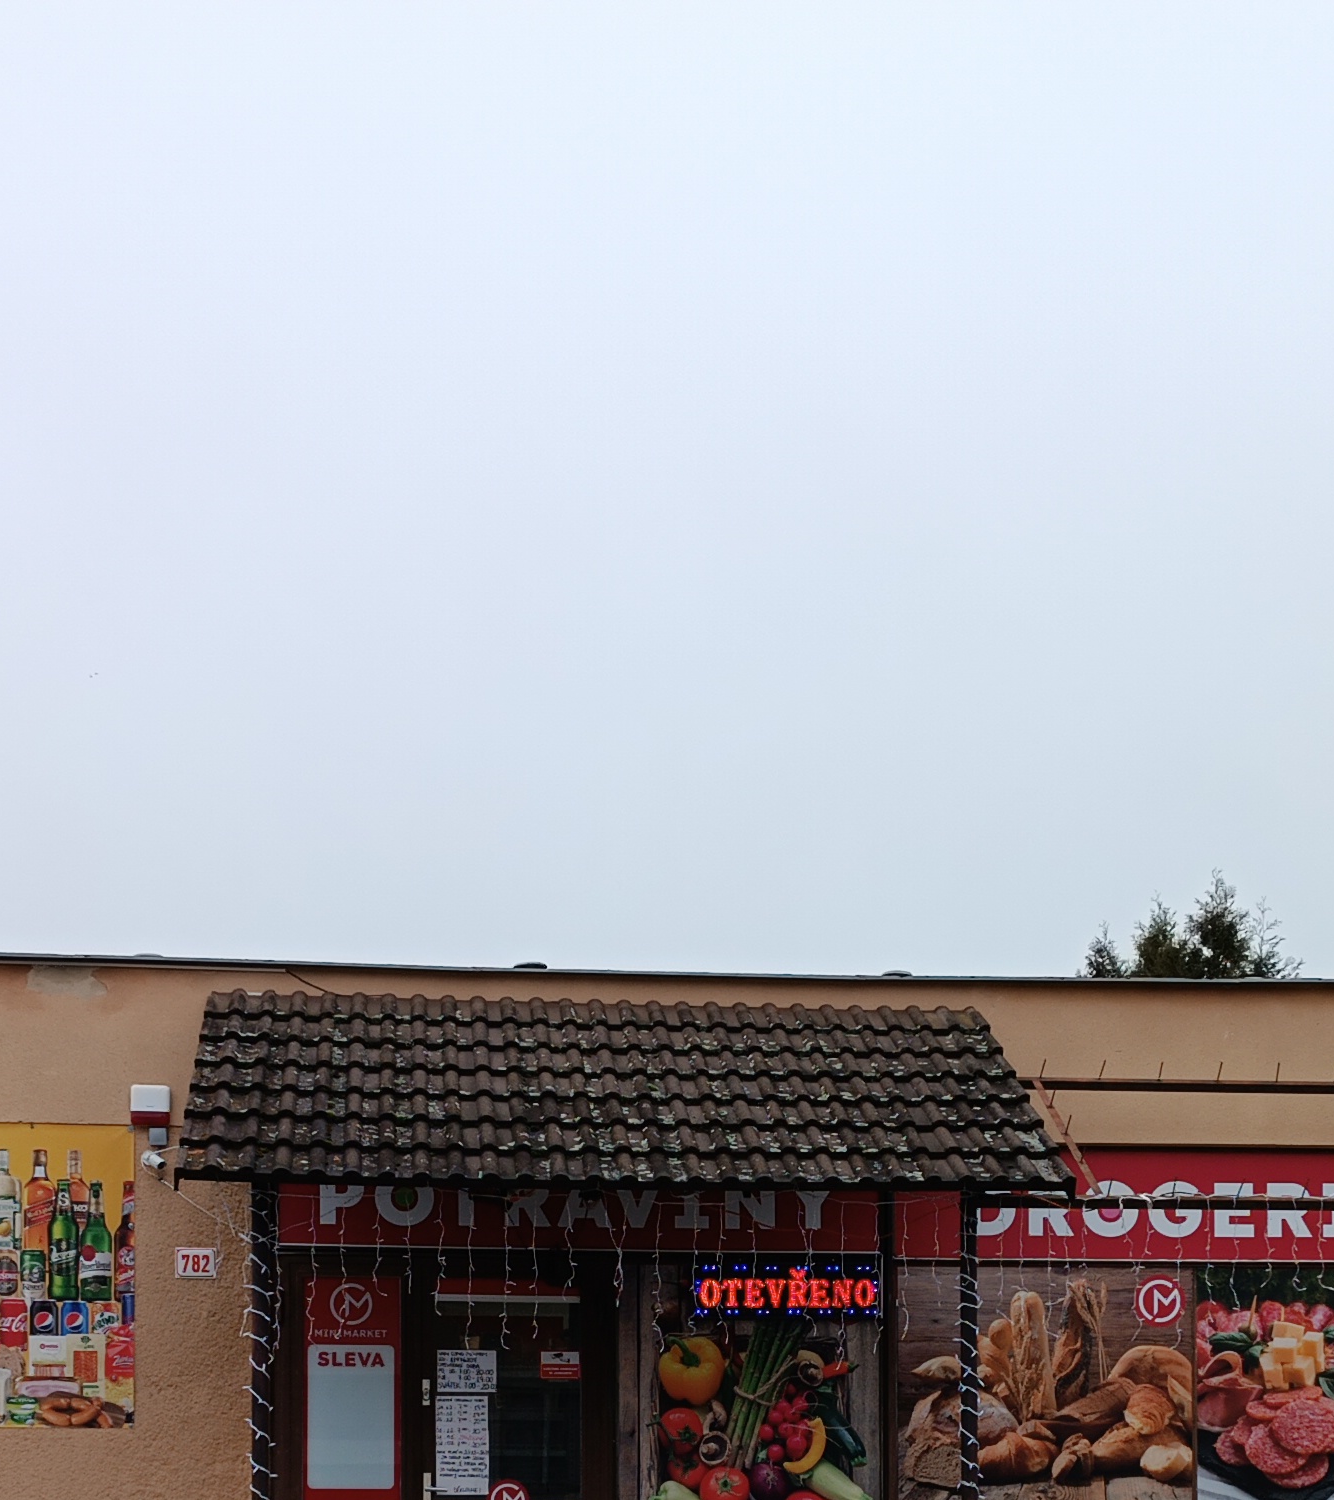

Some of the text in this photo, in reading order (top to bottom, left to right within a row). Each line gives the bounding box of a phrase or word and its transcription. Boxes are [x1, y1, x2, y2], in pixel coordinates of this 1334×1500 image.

[181, 1254, 211, 1273] 782
[698, 1267, 876, 1309] OTEVŘENO
[343, 1330, 387, 1338] MARKET
[318, 1351, 385, 1368] SLEVA
